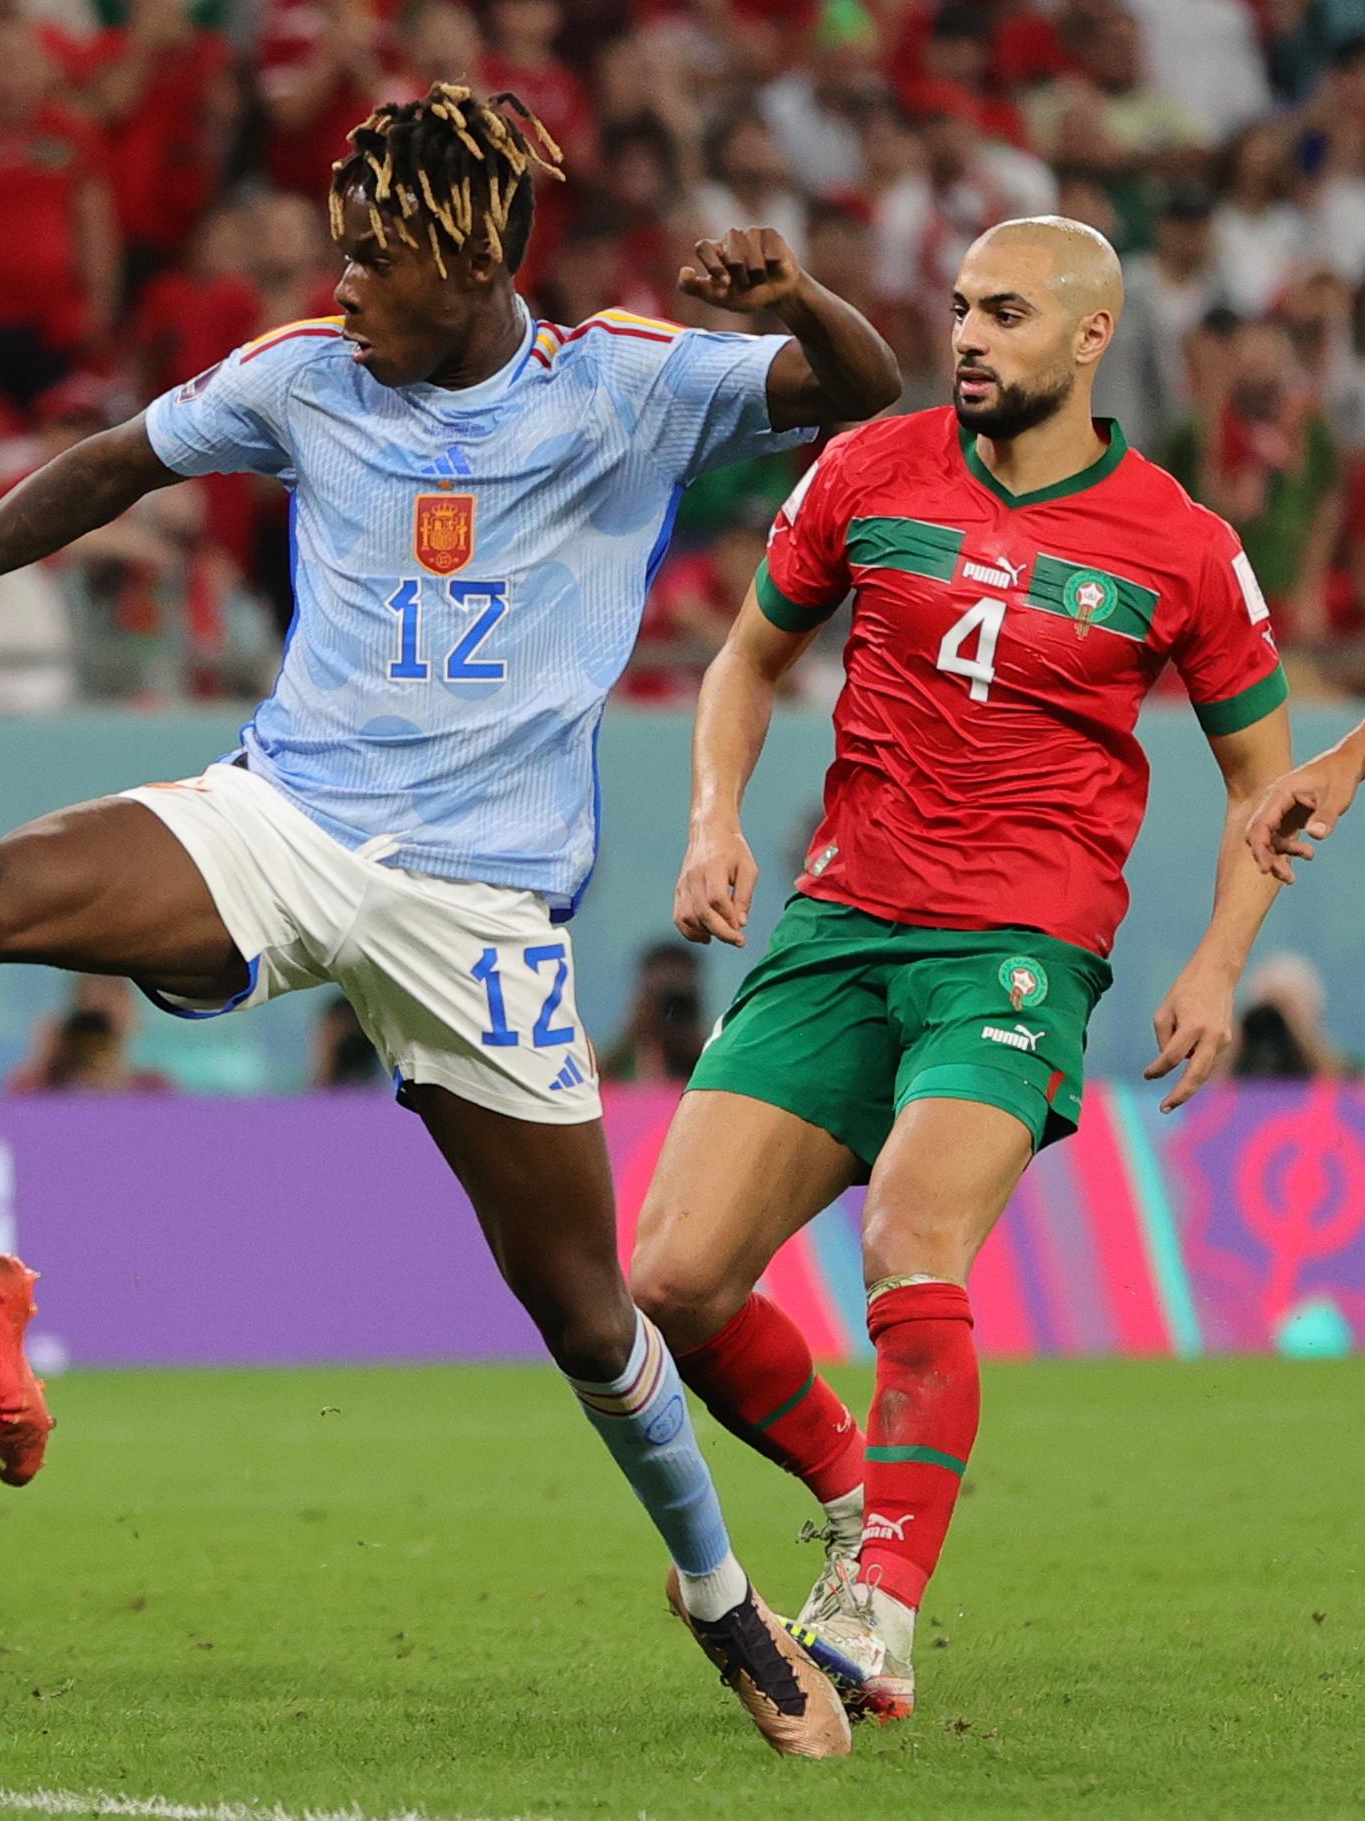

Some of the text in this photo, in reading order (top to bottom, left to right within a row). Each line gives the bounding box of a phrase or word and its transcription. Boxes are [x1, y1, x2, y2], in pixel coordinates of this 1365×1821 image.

[962, 562, 1011, 589] PUMA
[385, 576, 510, 682] 12
[936, 596, 1007, 703] 4
[470, 943, 575, 1048] 12
[981, 1026, 1030, 1051] PUMA
